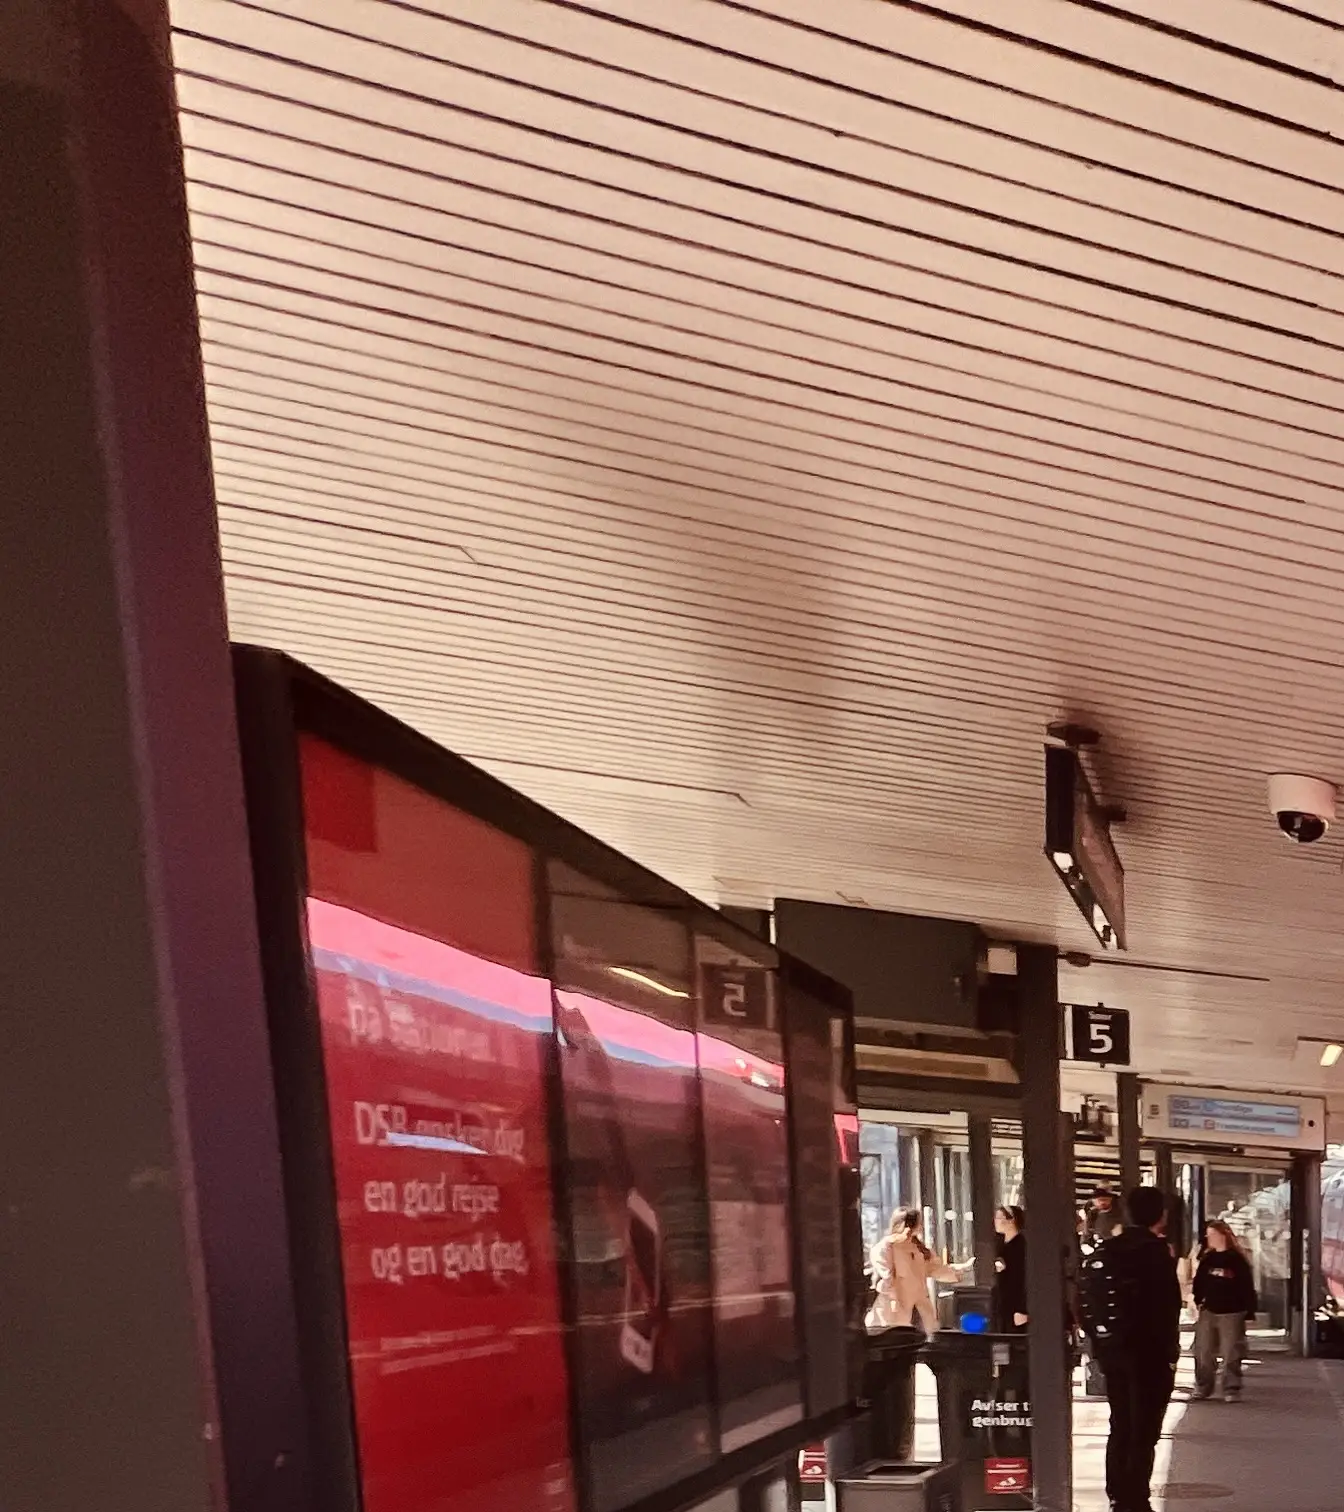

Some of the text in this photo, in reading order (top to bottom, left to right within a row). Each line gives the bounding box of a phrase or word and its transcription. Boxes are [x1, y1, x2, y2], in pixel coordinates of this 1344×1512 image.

[1089, 1023, 1113, 1054] 5
[364, 1180, 397, 1213] en
[403, 1172, 446, 1219] god
[371, 1243, 403, 1285] og
[407, 1246, 437, 1276] en
[971, 1399, 1020, 1412] Aviser
